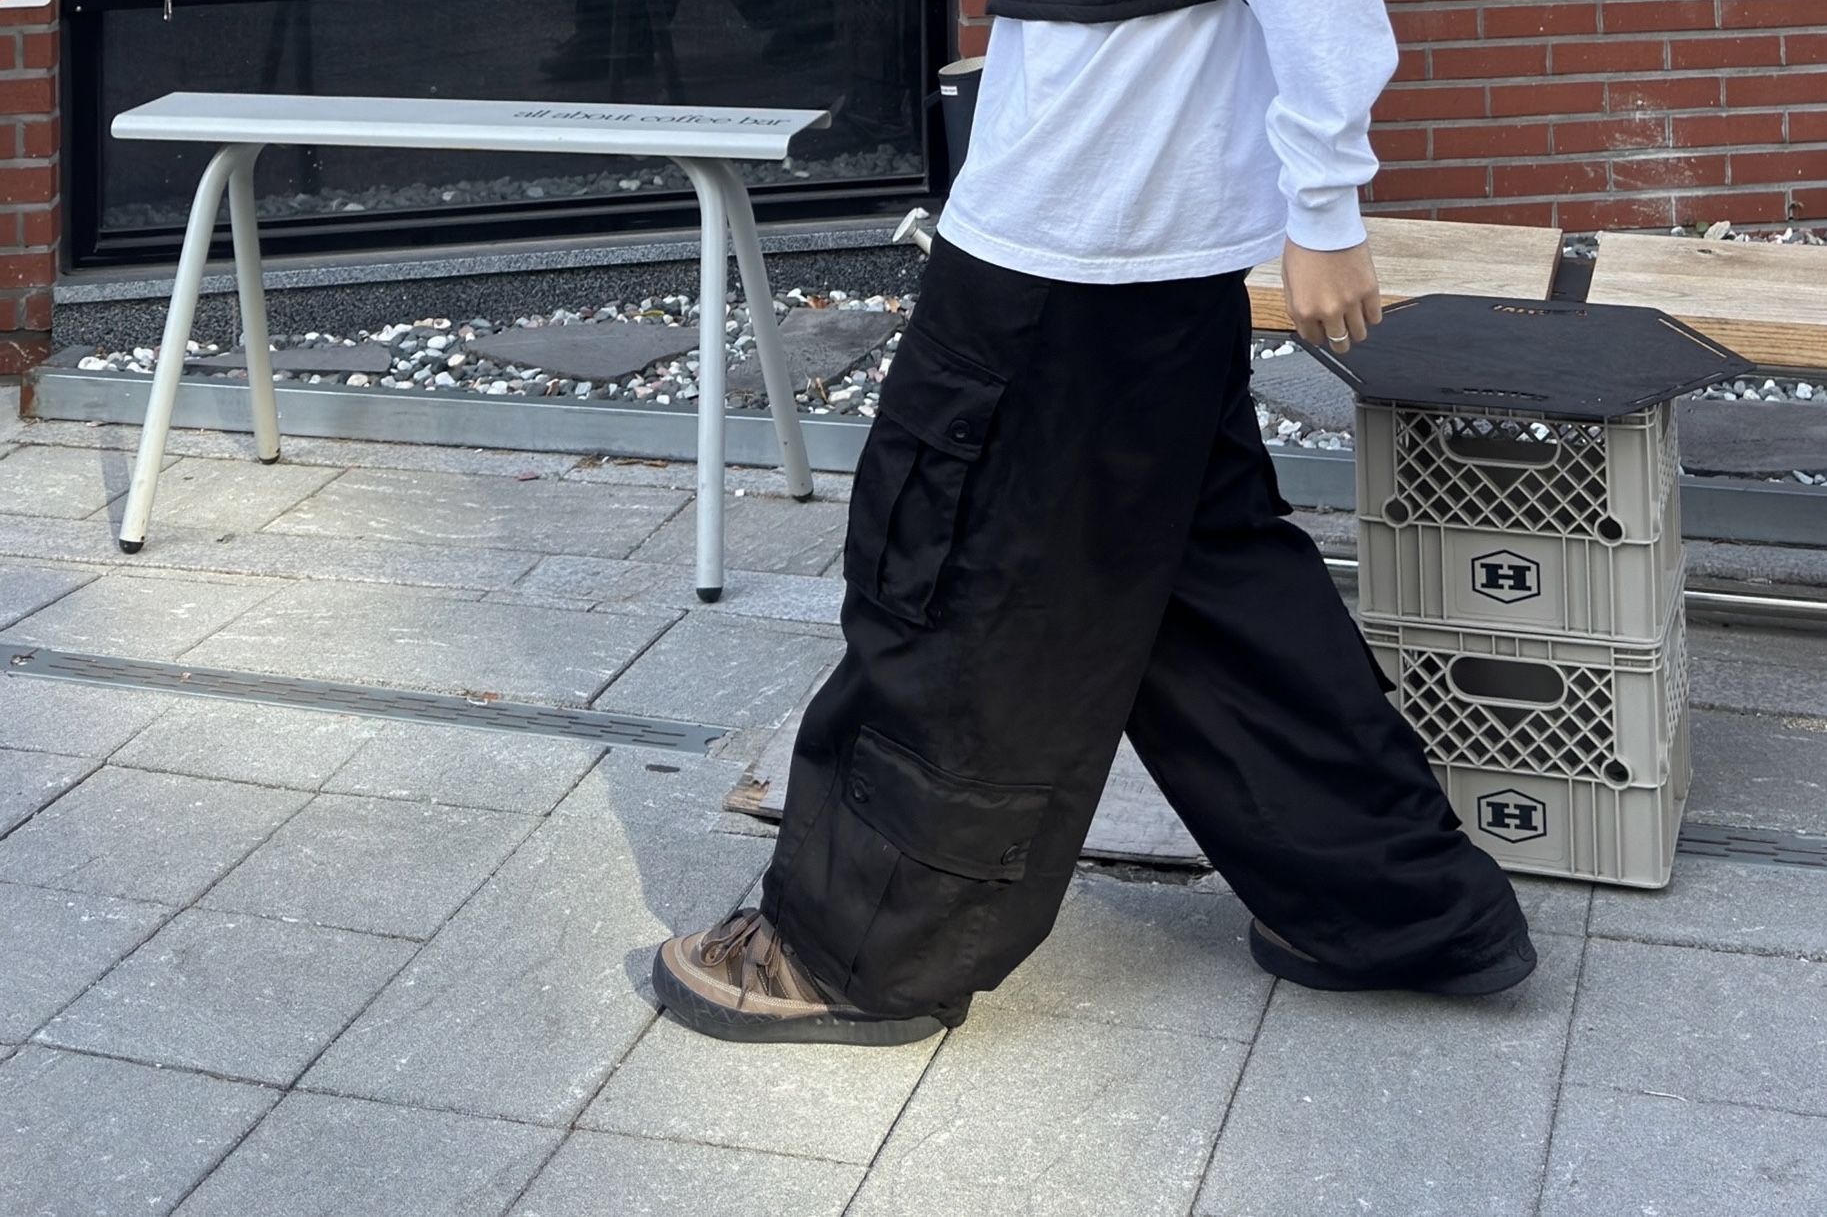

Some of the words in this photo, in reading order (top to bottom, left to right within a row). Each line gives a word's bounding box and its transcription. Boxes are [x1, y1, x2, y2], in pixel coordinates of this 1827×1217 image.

[513, 109, 551, 119] all
[552, 110, 634, 121] about
[640, 114, 732, 125] coffee
[737, 116, 790, 127] bar
[1480, 562, 1532, 592] H
[1486, 801, 1538, 832] H
